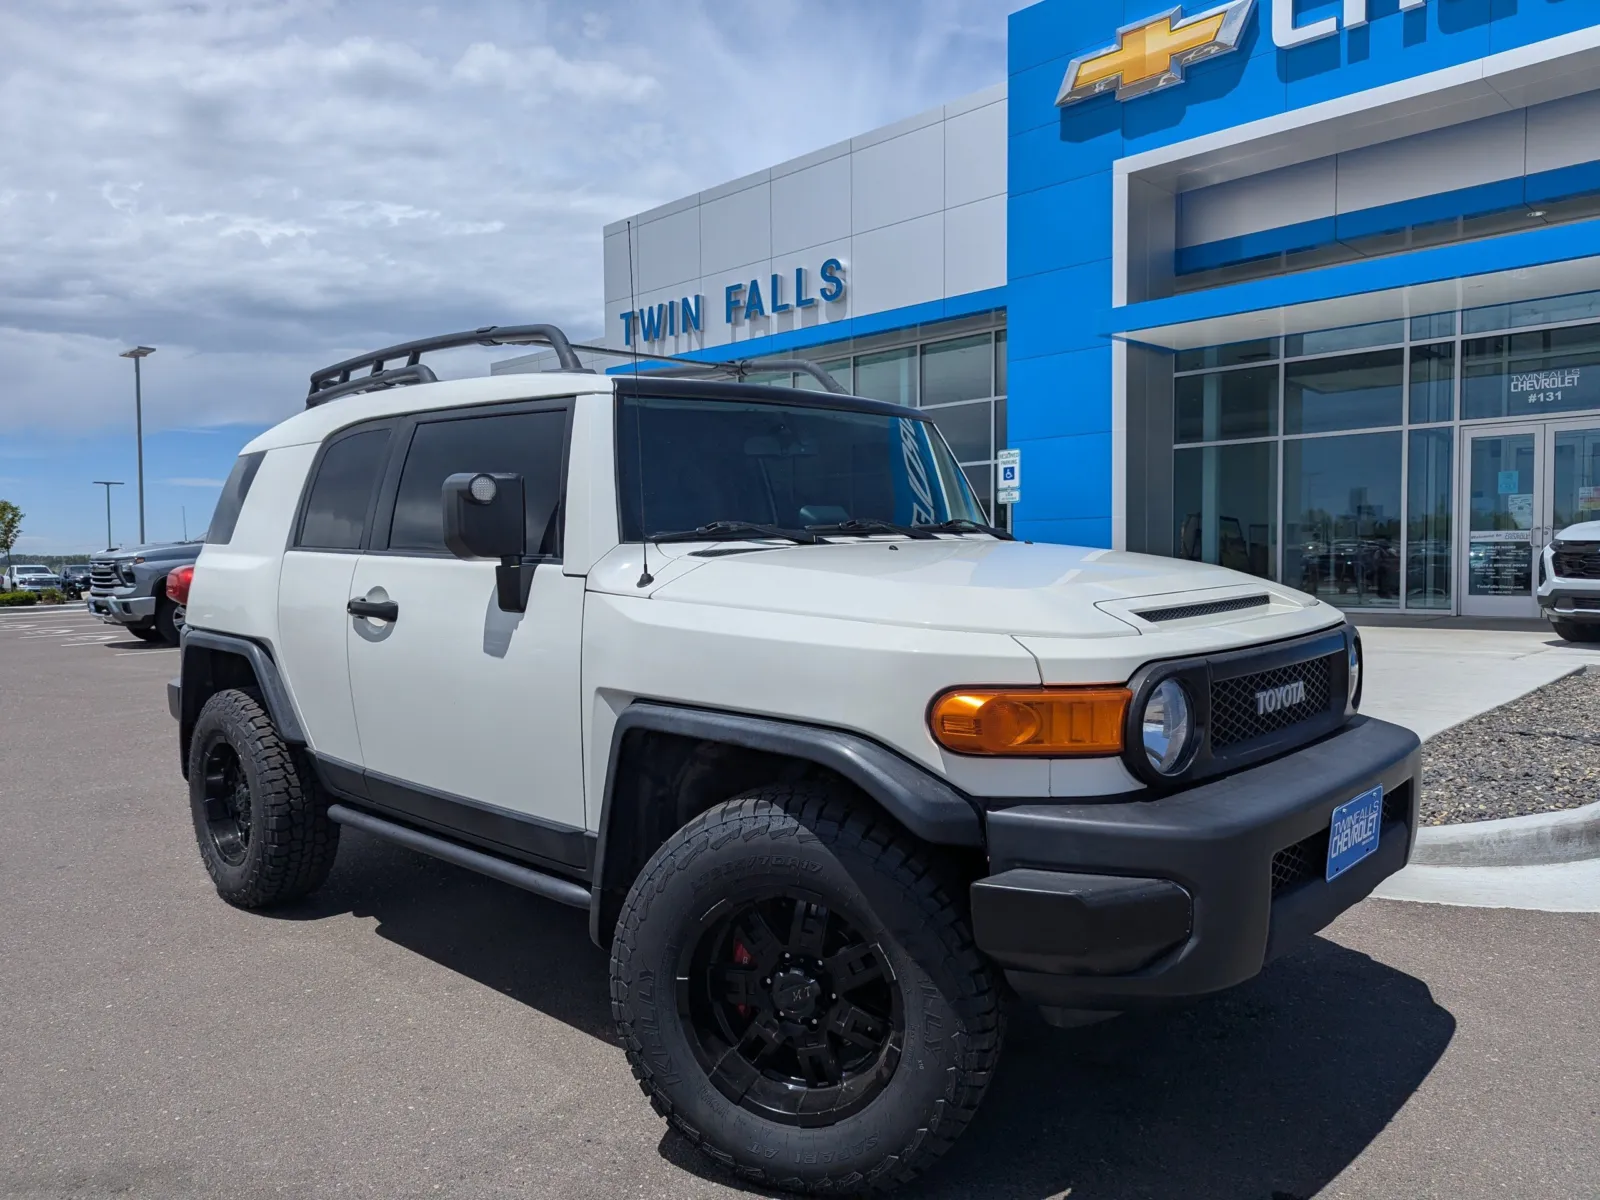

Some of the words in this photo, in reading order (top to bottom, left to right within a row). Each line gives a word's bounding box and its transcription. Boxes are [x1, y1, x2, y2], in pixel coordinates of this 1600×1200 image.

[620, 294, 704, 346] TWIN
[725, 258, 847, 324] FALLS
[1510, 375, 1580, 392] CHEVROLET
[1528, 391, 1562, 403] #131
[1255, 680, 1305, 715] TOYOTA
[1331, 813, 1379, 858] CHEVROLET
